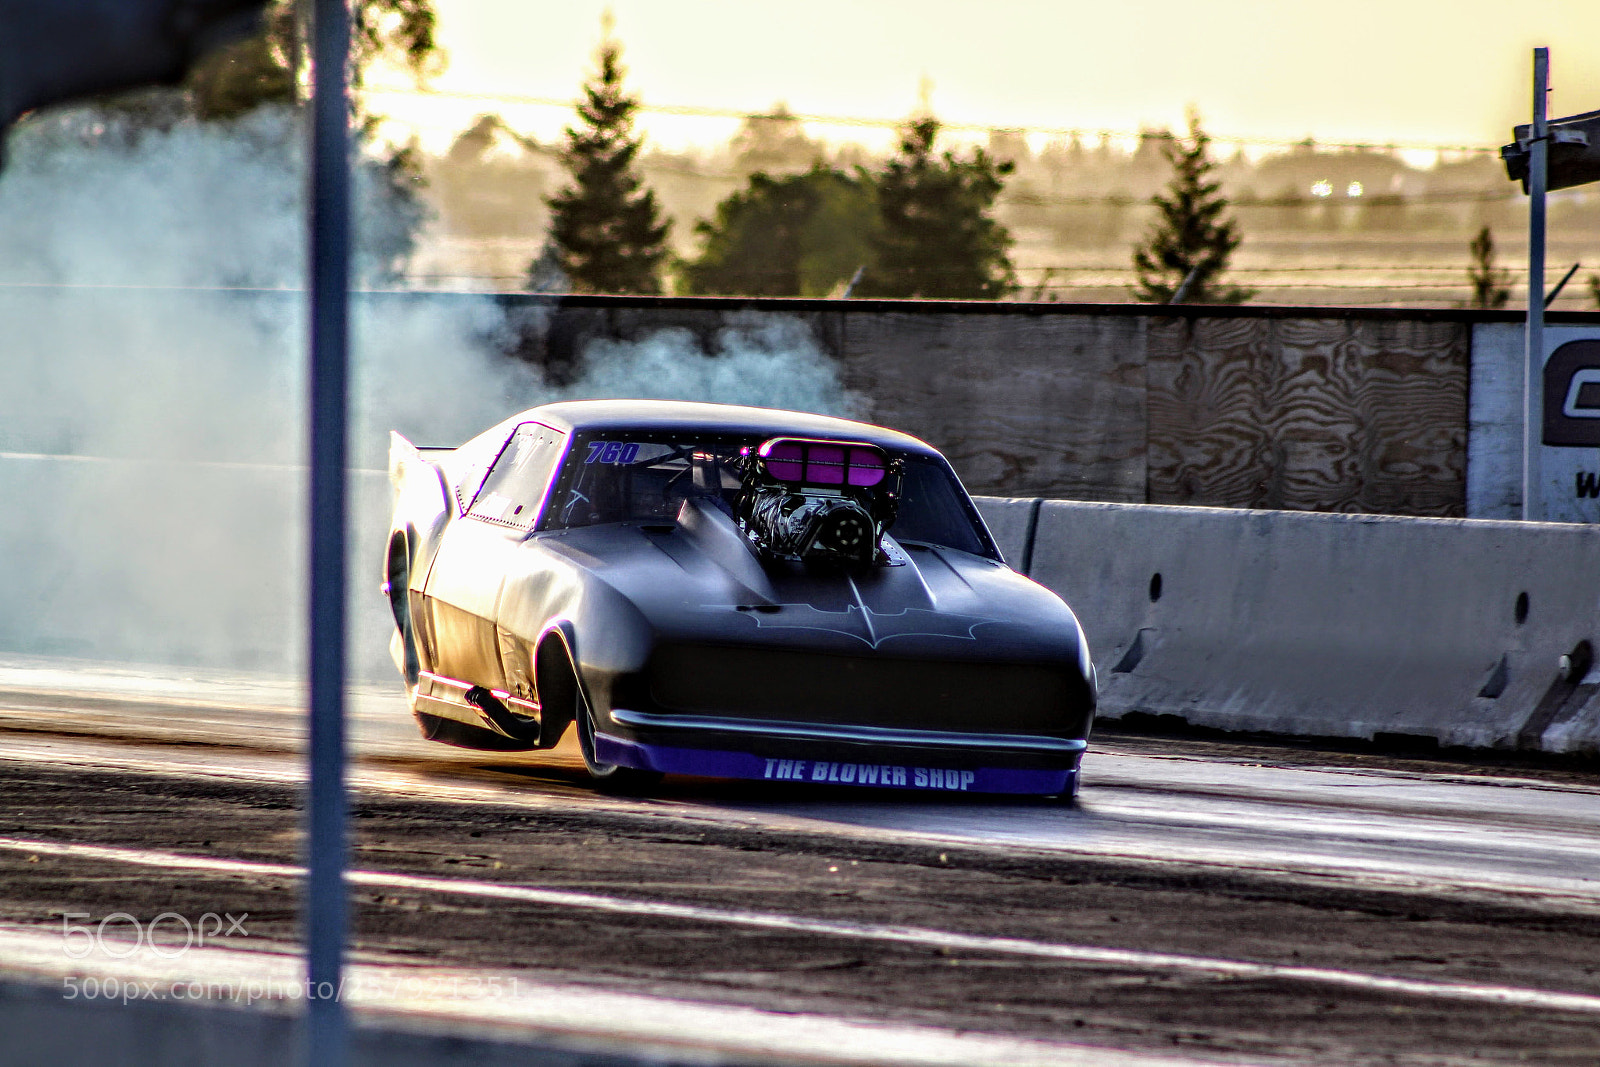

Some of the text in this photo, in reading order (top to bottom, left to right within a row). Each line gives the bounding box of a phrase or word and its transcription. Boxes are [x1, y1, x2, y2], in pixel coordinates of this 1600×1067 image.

[585, 441, 640, 464] 760
[764, 758, 975, 791] THE BLOWER SHOP
